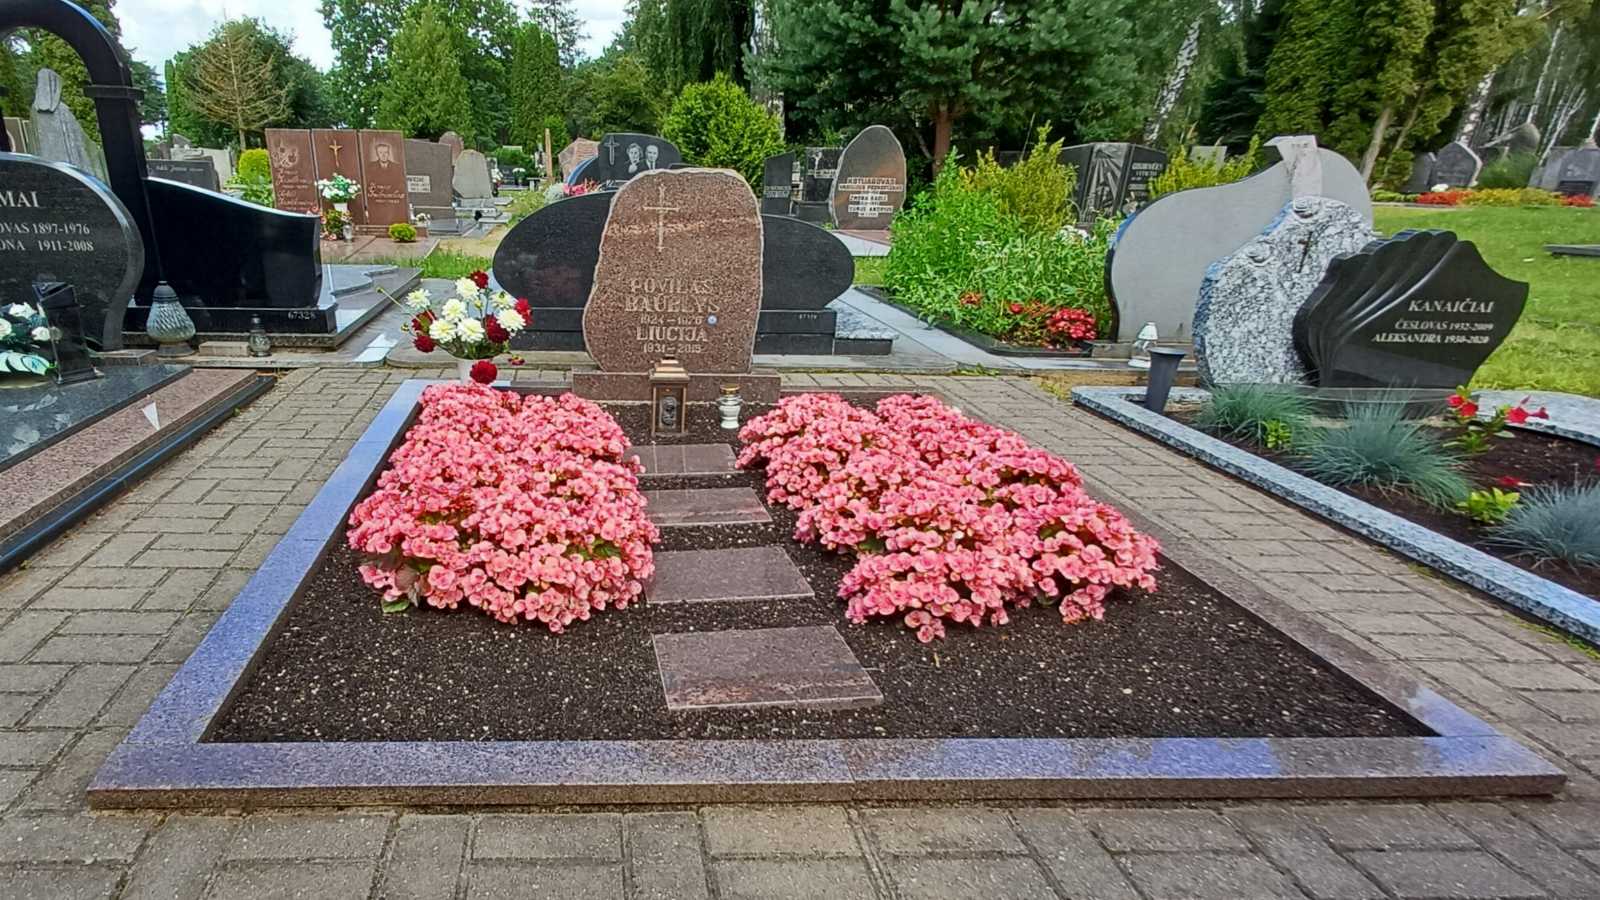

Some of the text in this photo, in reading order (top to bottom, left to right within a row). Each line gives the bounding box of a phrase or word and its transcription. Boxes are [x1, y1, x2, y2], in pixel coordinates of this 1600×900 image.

[32, 222, 91, 235] 1897-1976
[37, 239, 95, 252] 1911-2008
[631, 278, 714, 294] POVILAS
[1408, 298, 1495, 313] KANAIČIAI
[1394, 317, 1449, 330] ČESLOVAS
[636, 326, 709, 342] LIUCIJA
[1371, 332, 1442, 343] ALEKSANDRA
